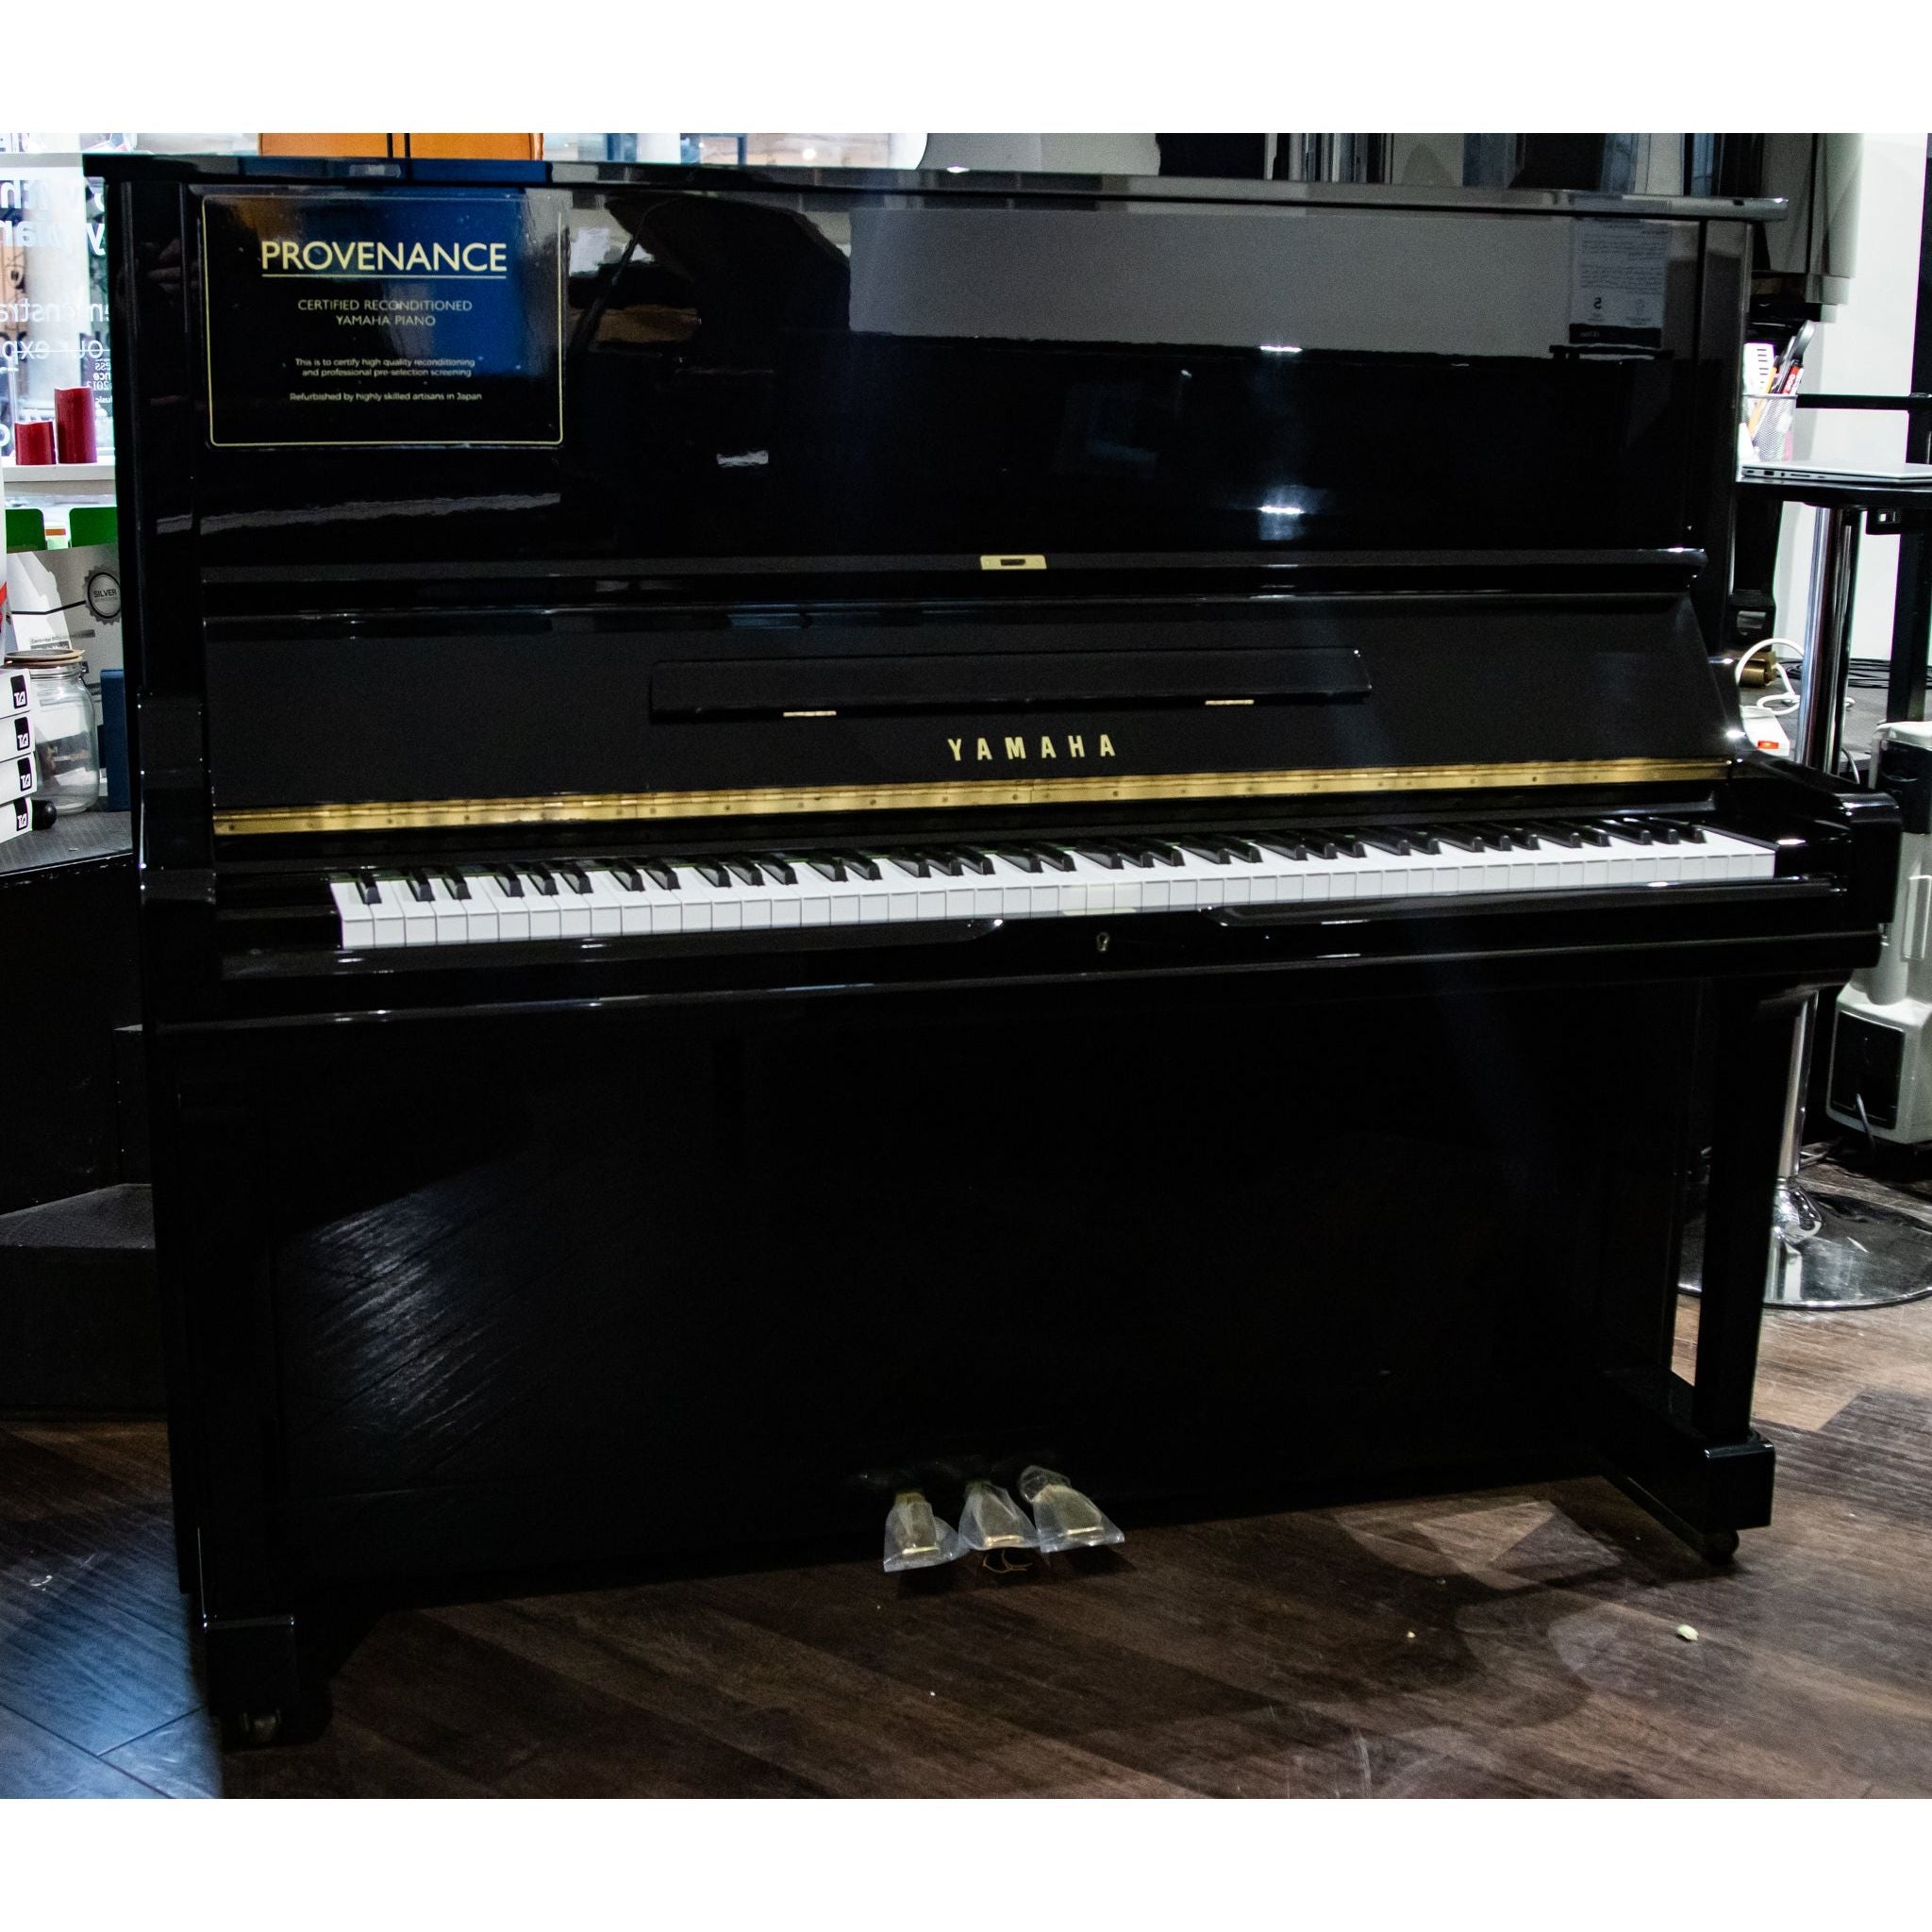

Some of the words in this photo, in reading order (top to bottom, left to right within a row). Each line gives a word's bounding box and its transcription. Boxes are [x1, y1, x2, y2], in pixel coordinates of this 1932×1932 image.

[260, 241, 508, 273] PROVENANCE
[297, 299, 359, 310] CERTIFIED
[363, 299, 473, 311] RECONDITIONED
[335, 314, 391, 325] YAMAHA
[394, 315, 436, 326] PIANO
[294, 358, 312, 366] This
[314, 358, 321, 366] is
[322, 358, 332, 366] to
[333, 358, 360, 368] certify
[361, 358, 381, 368] high
[382, 358, 412, 368] quality
[413, 358, 475, 368] reconditioning
[302, 368, 320, 376] and
[321, 368, 373, 377] professional
[374, 368, 429, 377] pre-selection
[429, 369, 472, 378] screening
[289, 391, 341, 401] Refurbished
[342, 391, 355, 403] by
[356, 391, 383, 403] highly
[383, 391, 411, 401] skilled
[412, 391, 444, 401] artisans
[446, 392, 455, 401] in
[456, 391, 483, 402] Japan
[92, 588, 117, 598] SILVER
[946, 733, 1116, 762] YAMAHA
